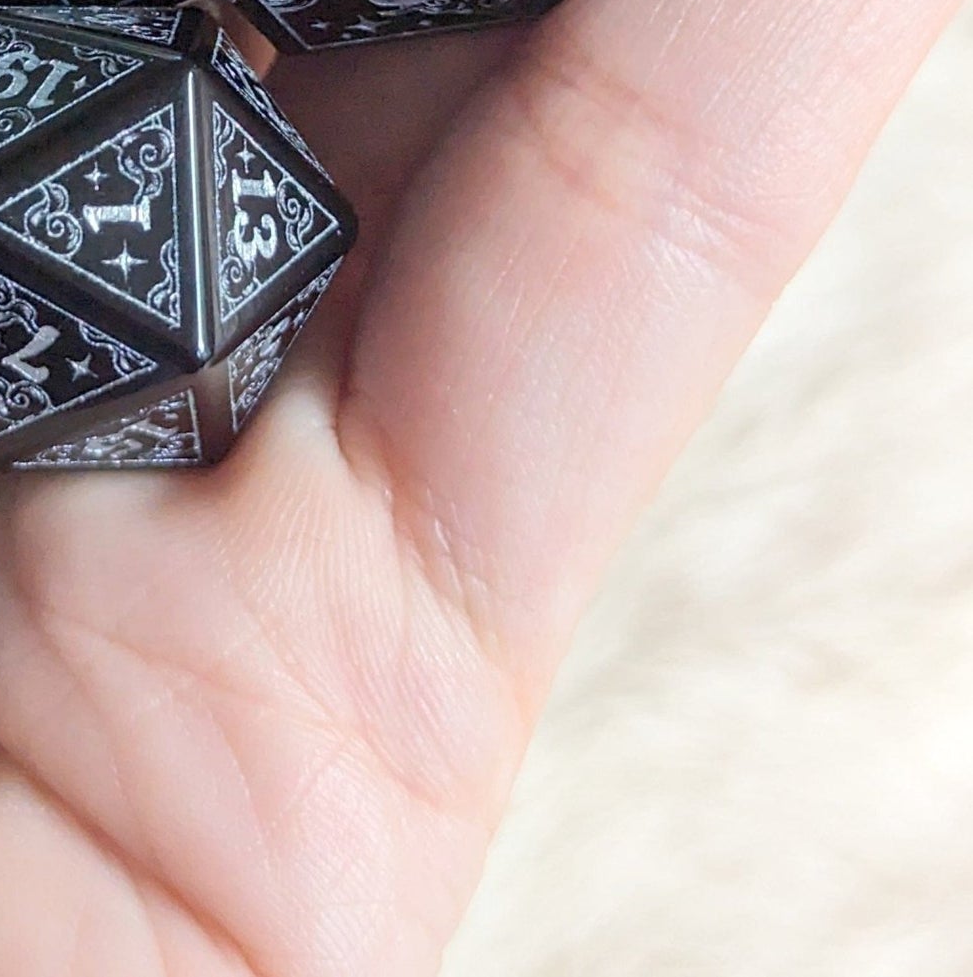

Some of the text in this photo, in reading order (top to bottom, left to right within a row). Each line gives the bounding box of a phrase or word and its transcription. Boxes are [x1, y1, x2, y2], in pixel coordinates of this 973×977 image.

[83, 198, 151, 232] 1
[232, 168, 277, 261] 13
[1, 326, 60, 383] 7
